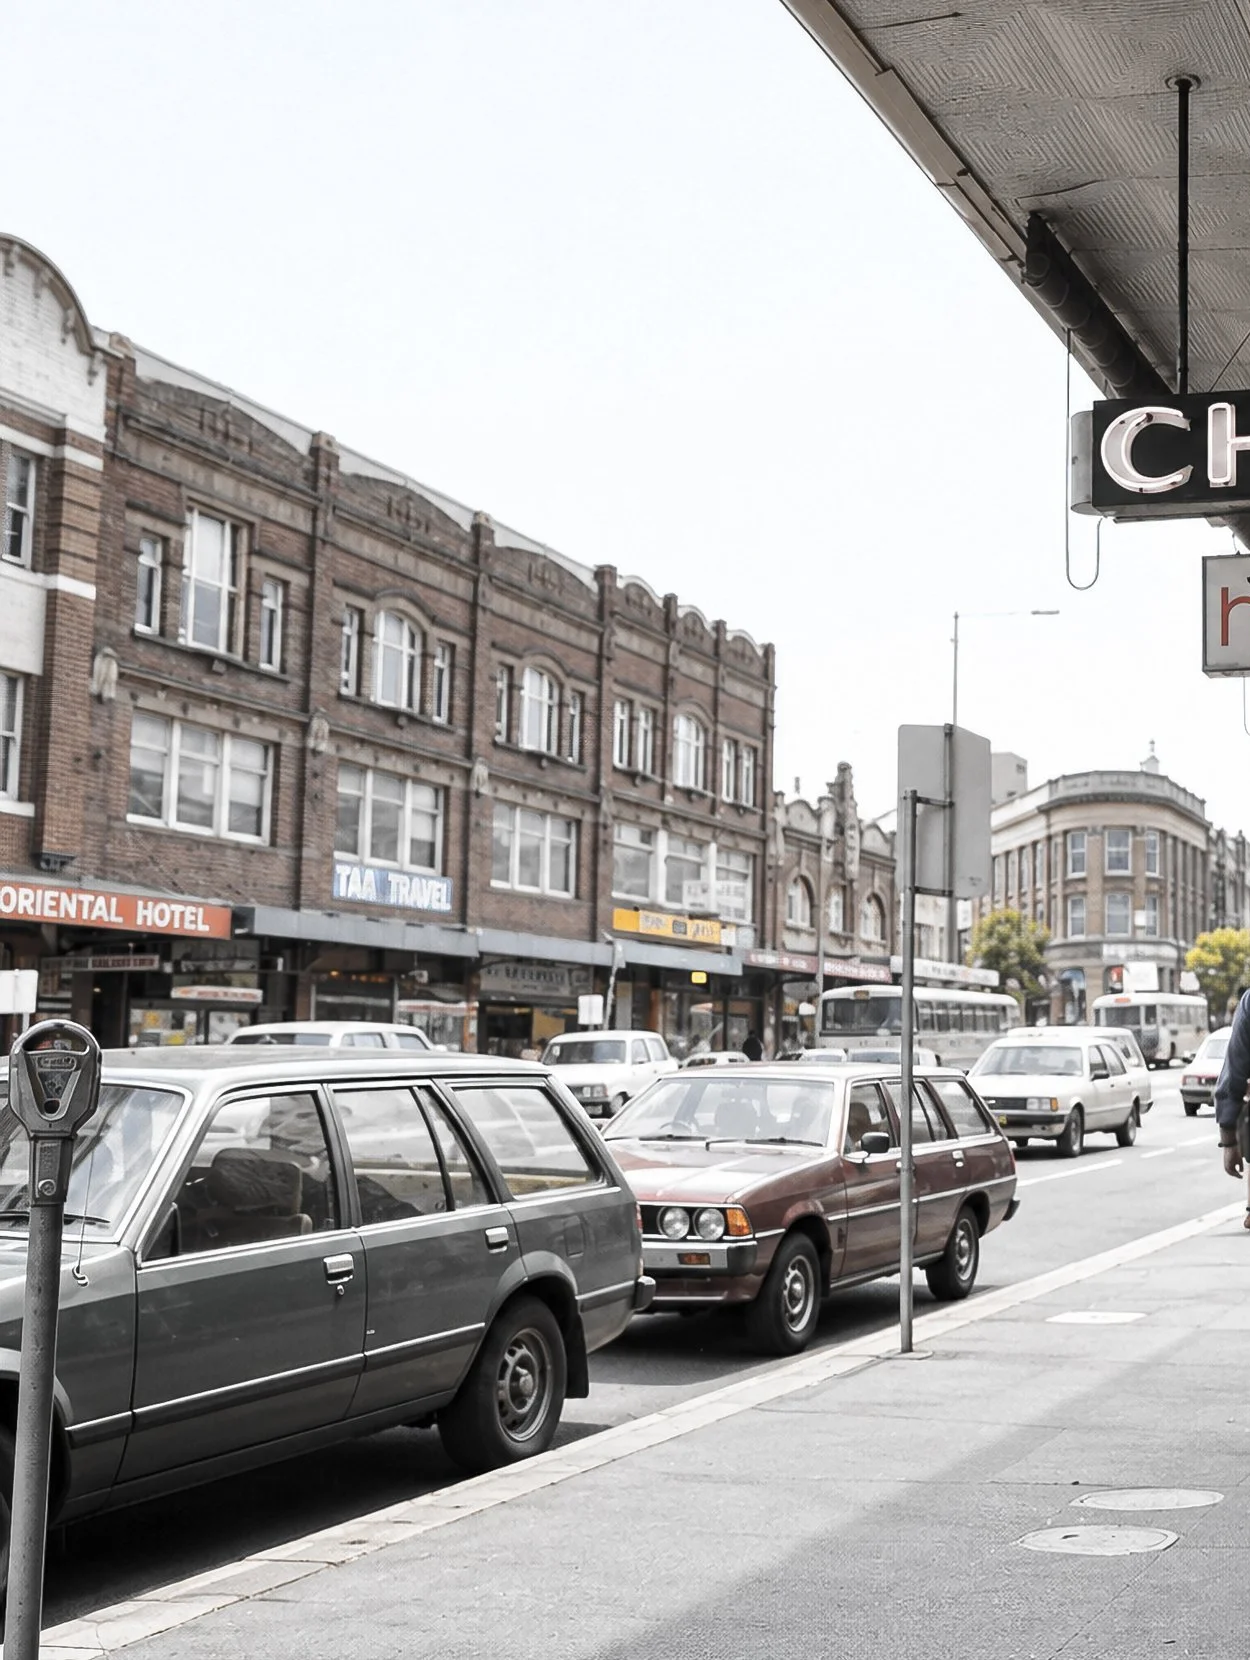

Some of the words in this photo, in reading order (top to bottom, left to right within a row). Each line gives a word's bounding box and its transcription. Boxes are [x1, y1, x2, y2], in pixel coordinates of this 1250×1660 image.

[0, 886, 124, 924] ORIENTAL
[136, 900, 210, 932] HOTEL
[335, 864, 377, 900] TAA
[387, 872, 451, 911] TRAVEL
